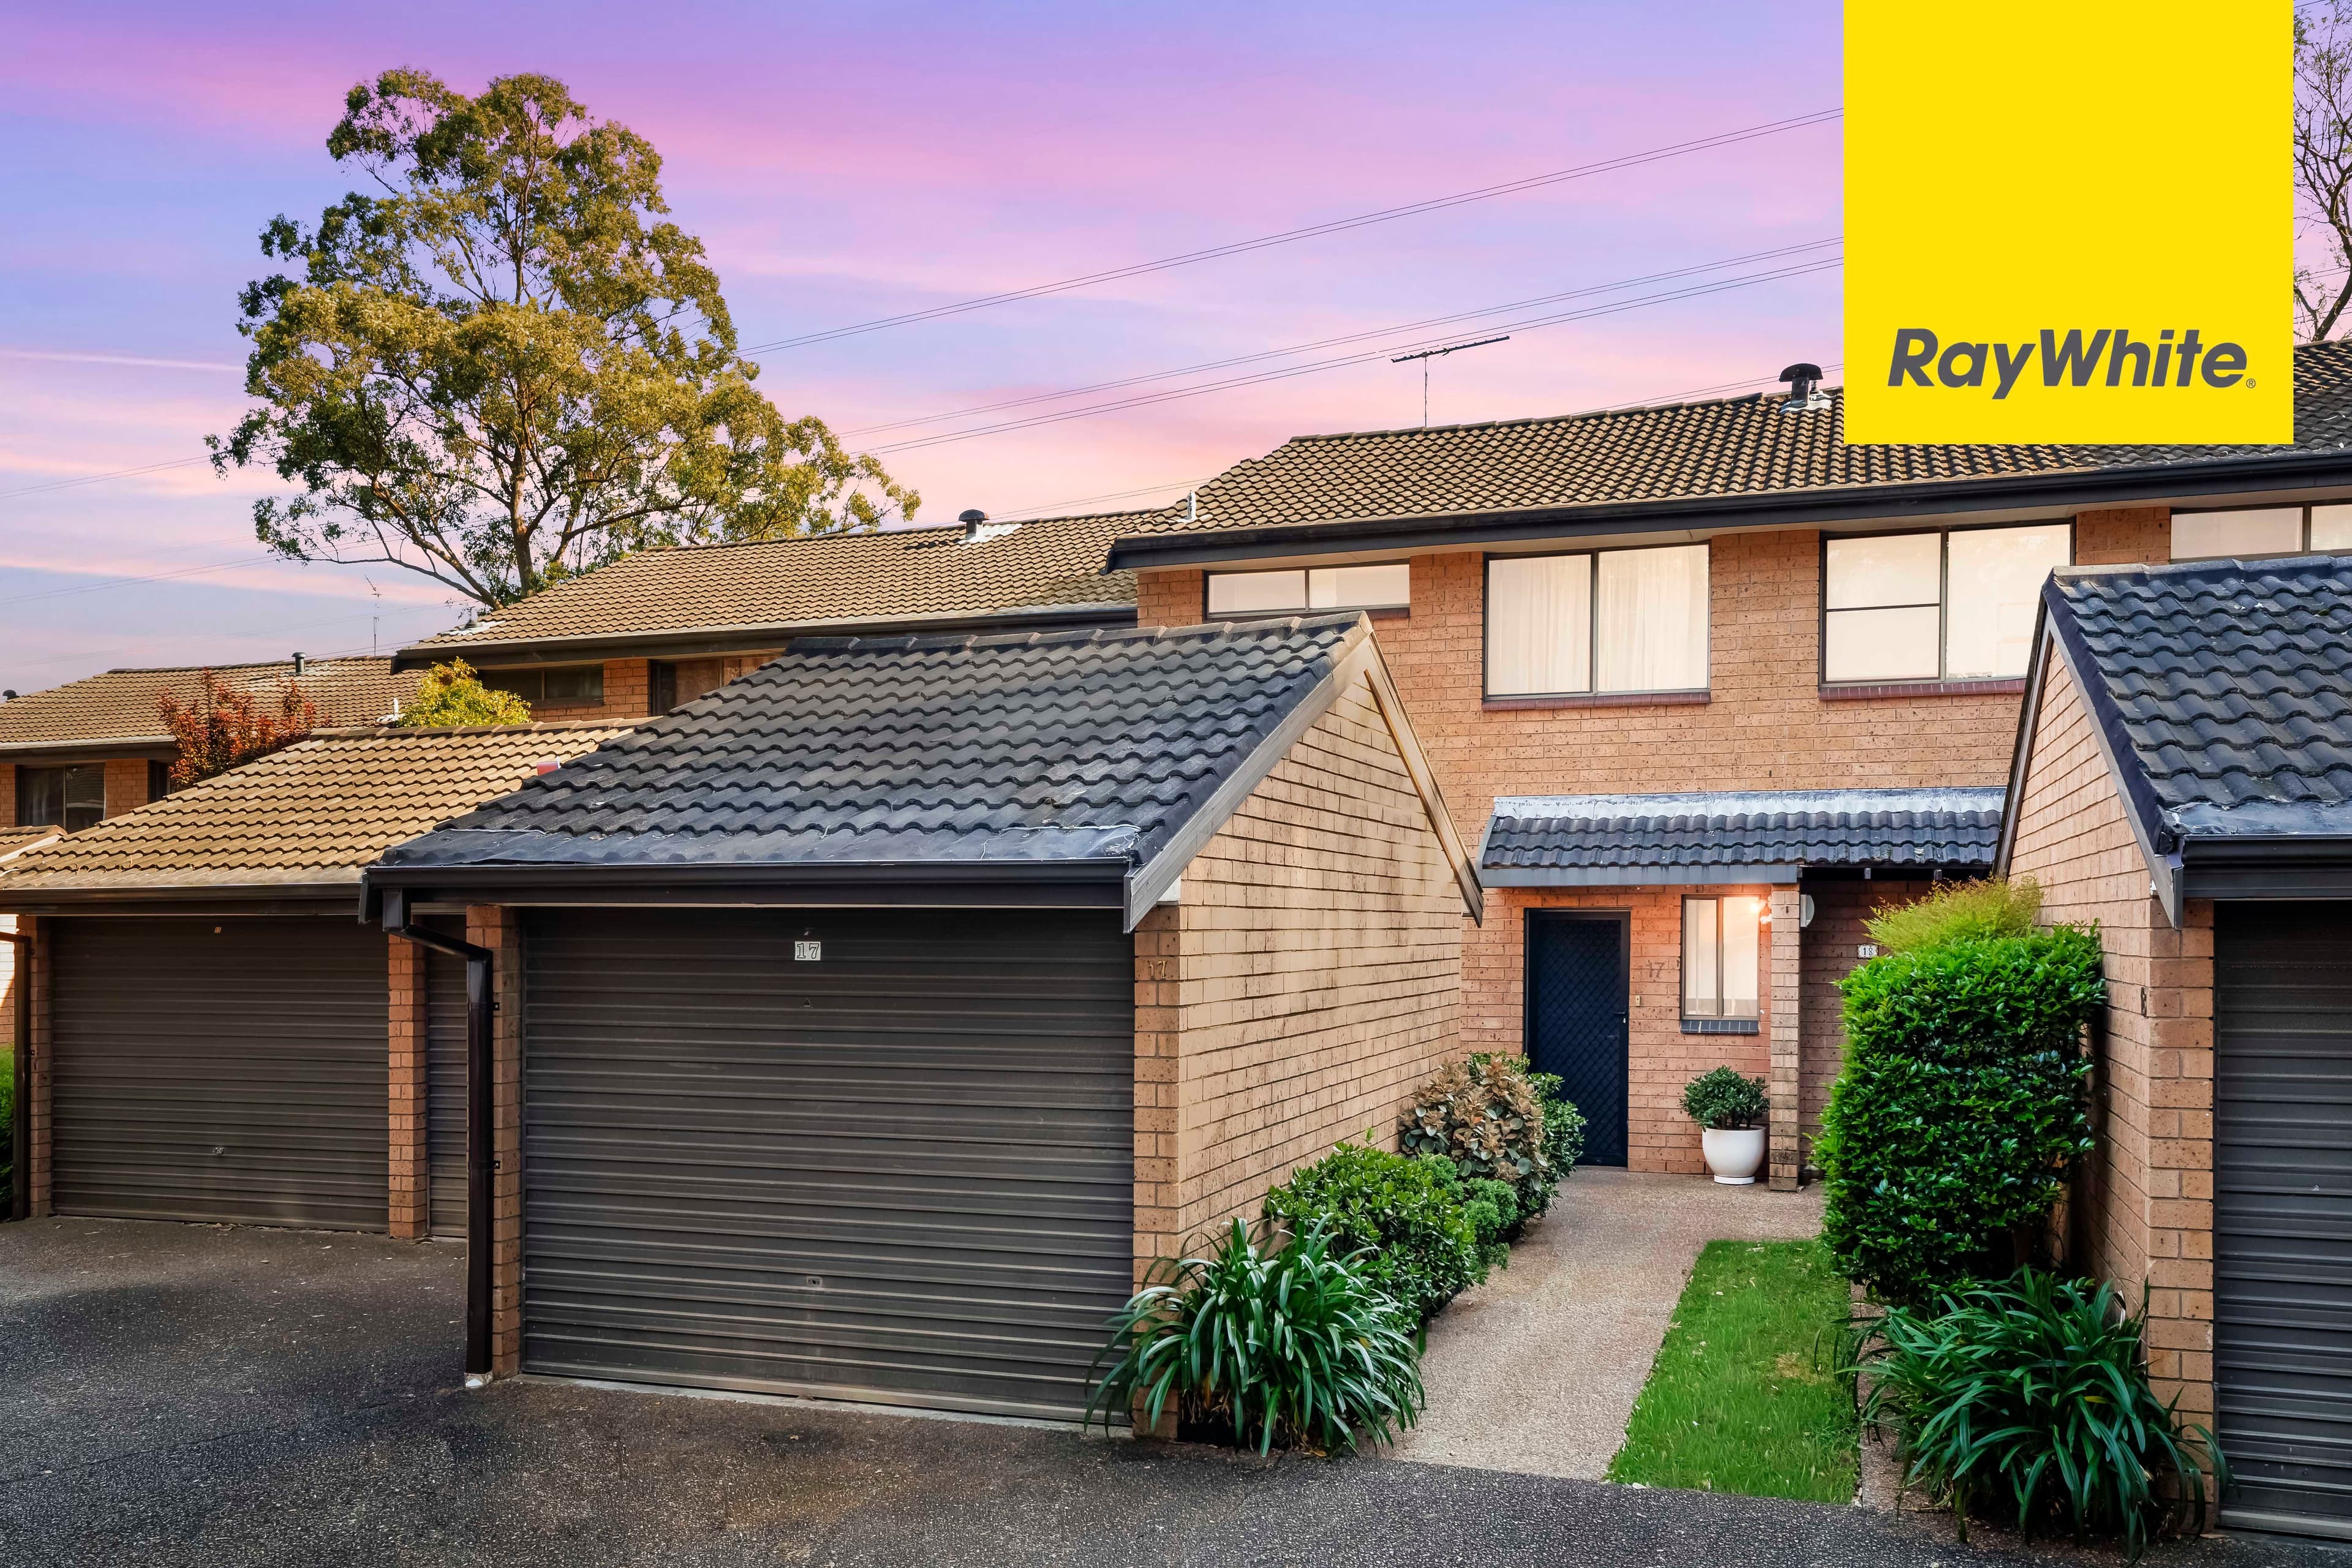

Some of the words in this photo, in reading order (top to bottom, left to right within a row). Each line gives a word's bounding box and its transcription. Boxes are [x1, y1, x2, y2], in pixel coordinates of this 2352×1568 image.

[797, 943, 820, 959] 17
[1863, 948, 1873, 956] 18
[1646, 962, 1665, 978] 17
